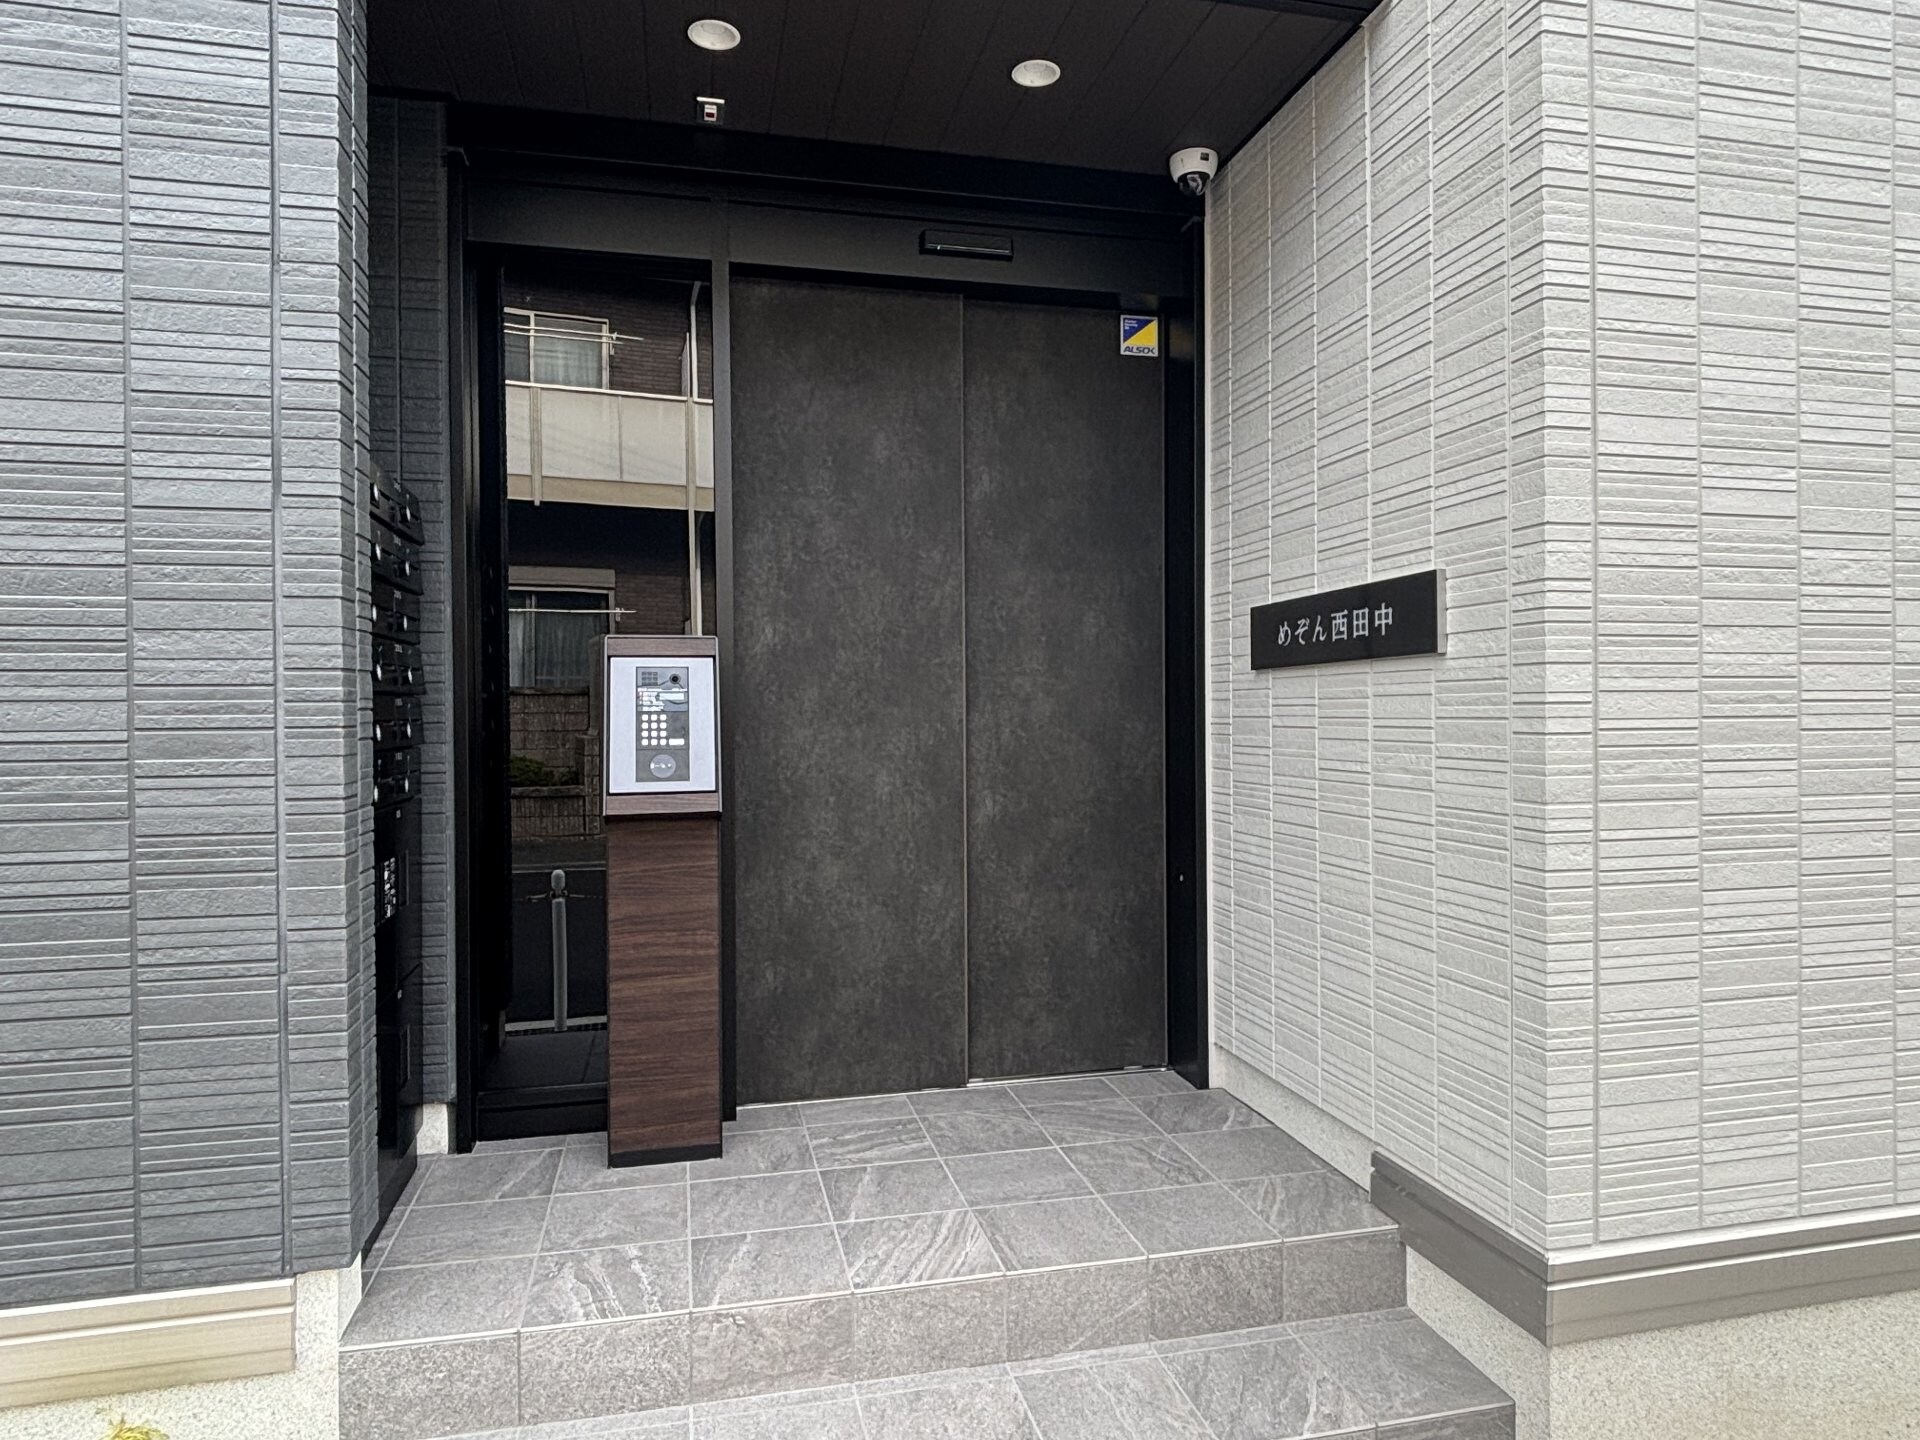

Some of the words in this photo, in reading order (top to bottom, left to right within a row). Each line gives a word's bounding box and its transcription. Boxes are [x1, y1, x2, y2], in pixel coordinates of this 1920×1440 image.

[1277, 602, 1393, 646] めぞん西田中
